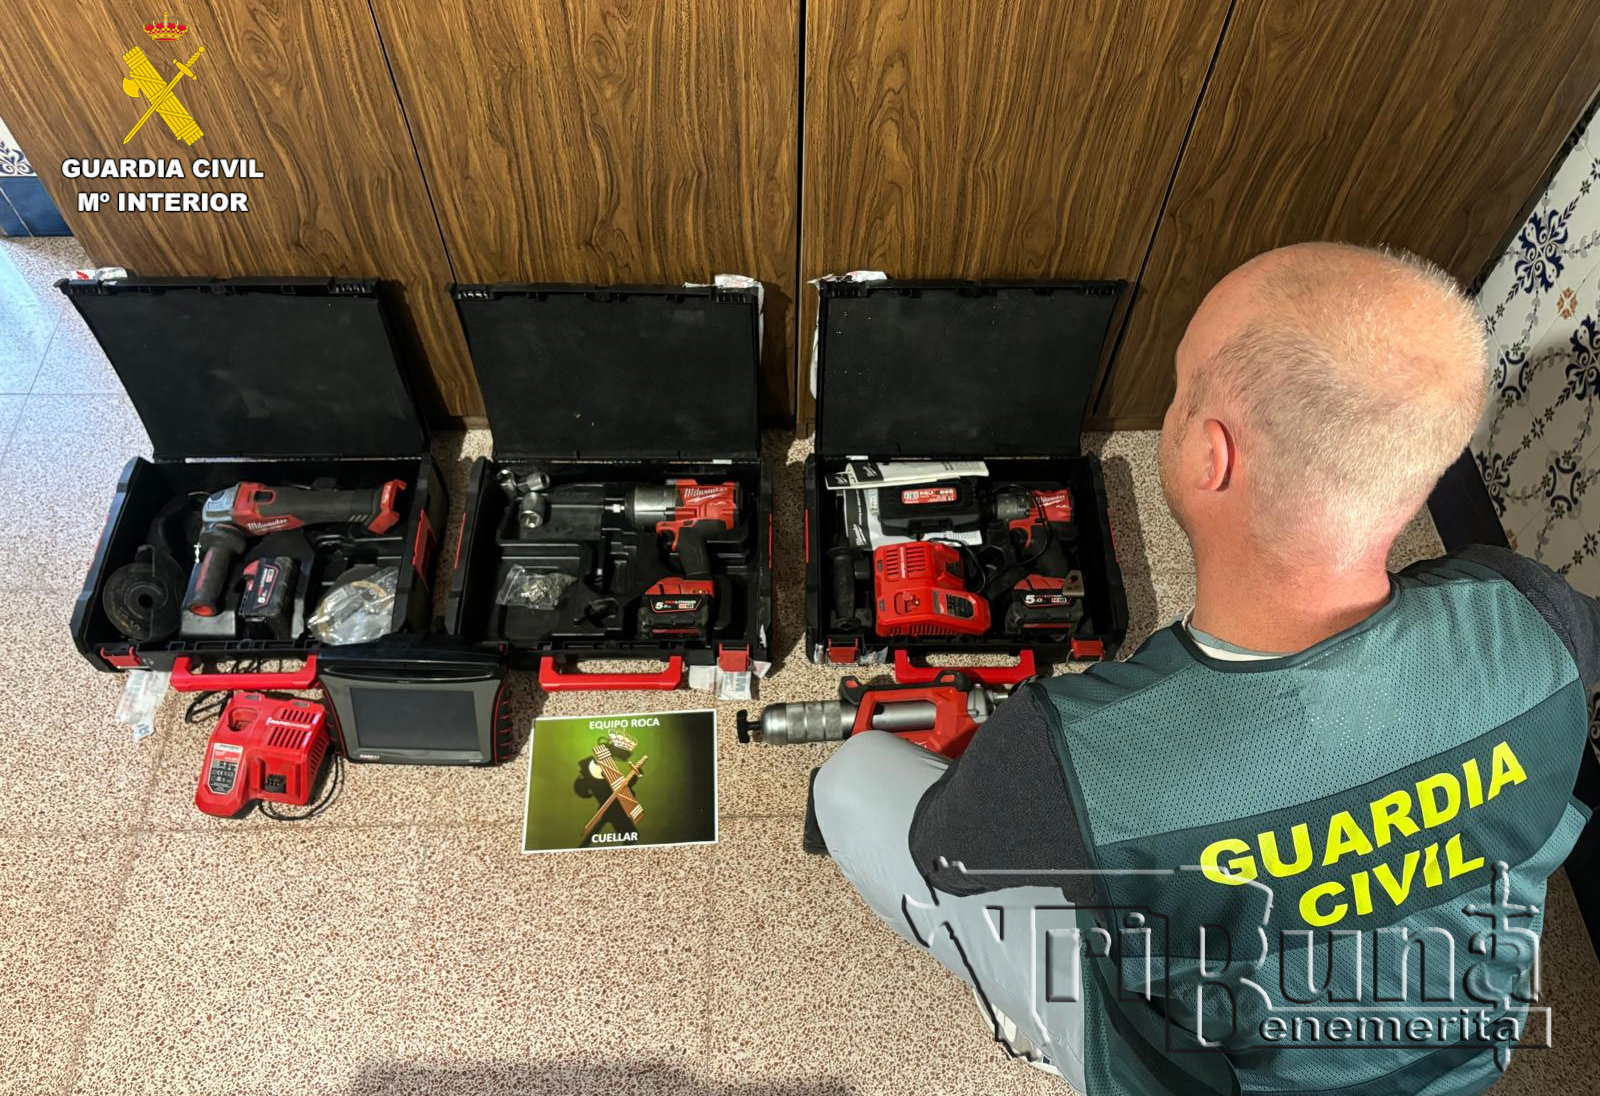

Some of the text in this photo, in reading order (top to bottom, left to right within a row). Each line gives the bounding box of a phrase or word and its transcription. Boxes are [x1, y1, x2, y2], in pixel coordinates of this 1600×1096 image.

[588, 717, 661, 730] EQUIPO ROCA
[591, 831, 639, 844] CUELLAR
[1200, 740, 1528, 886] GUARDIA
[1299, 833, 1485, 927] CIVIL
